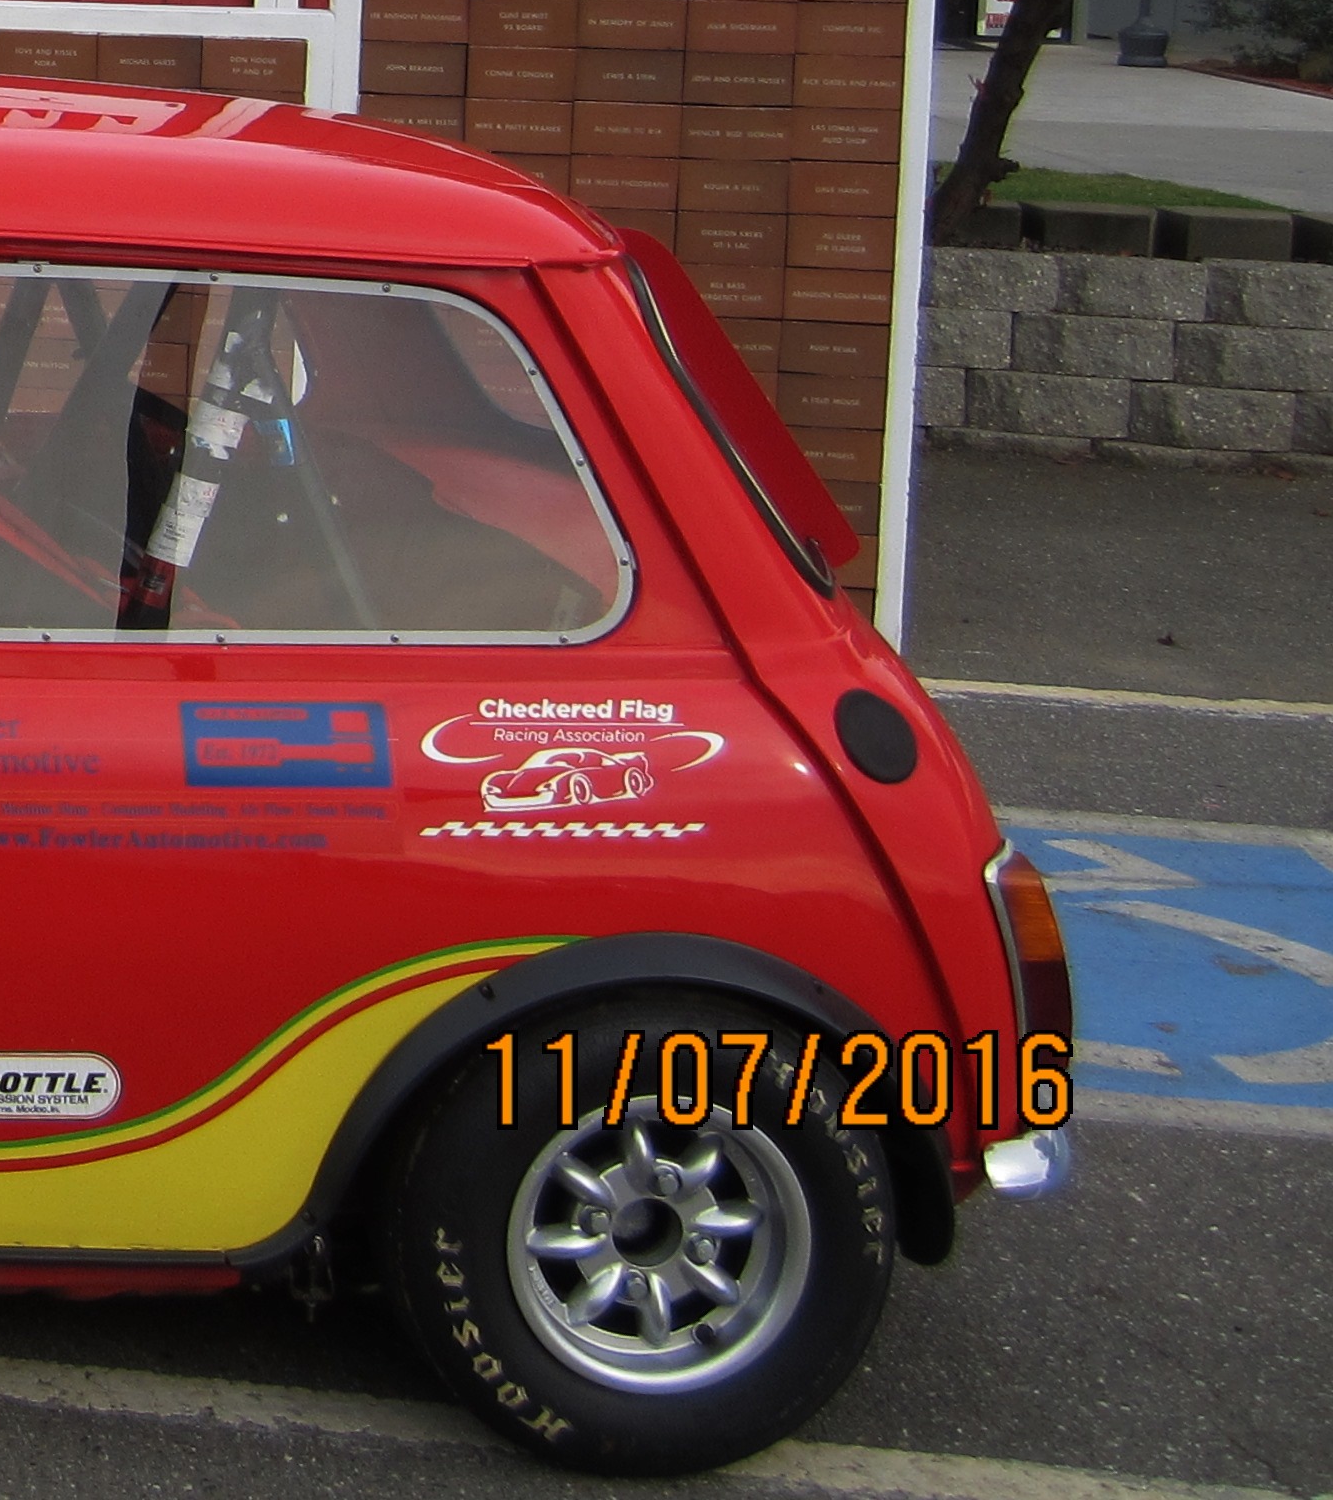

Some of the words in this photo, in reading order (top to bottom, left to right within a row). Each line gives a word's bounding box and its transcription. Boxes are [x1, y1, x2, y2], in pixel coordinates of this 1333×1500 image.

[478, 698, 613, 719] Checkered
[619, 699, 674, 723] Flag
[493, 728, 549, 744] Racing
[552, 728, 645, 743] Association
[36, 1095, 89, 1105] SYSTEM
[433, 1227, 574, 1443] Hoosier
